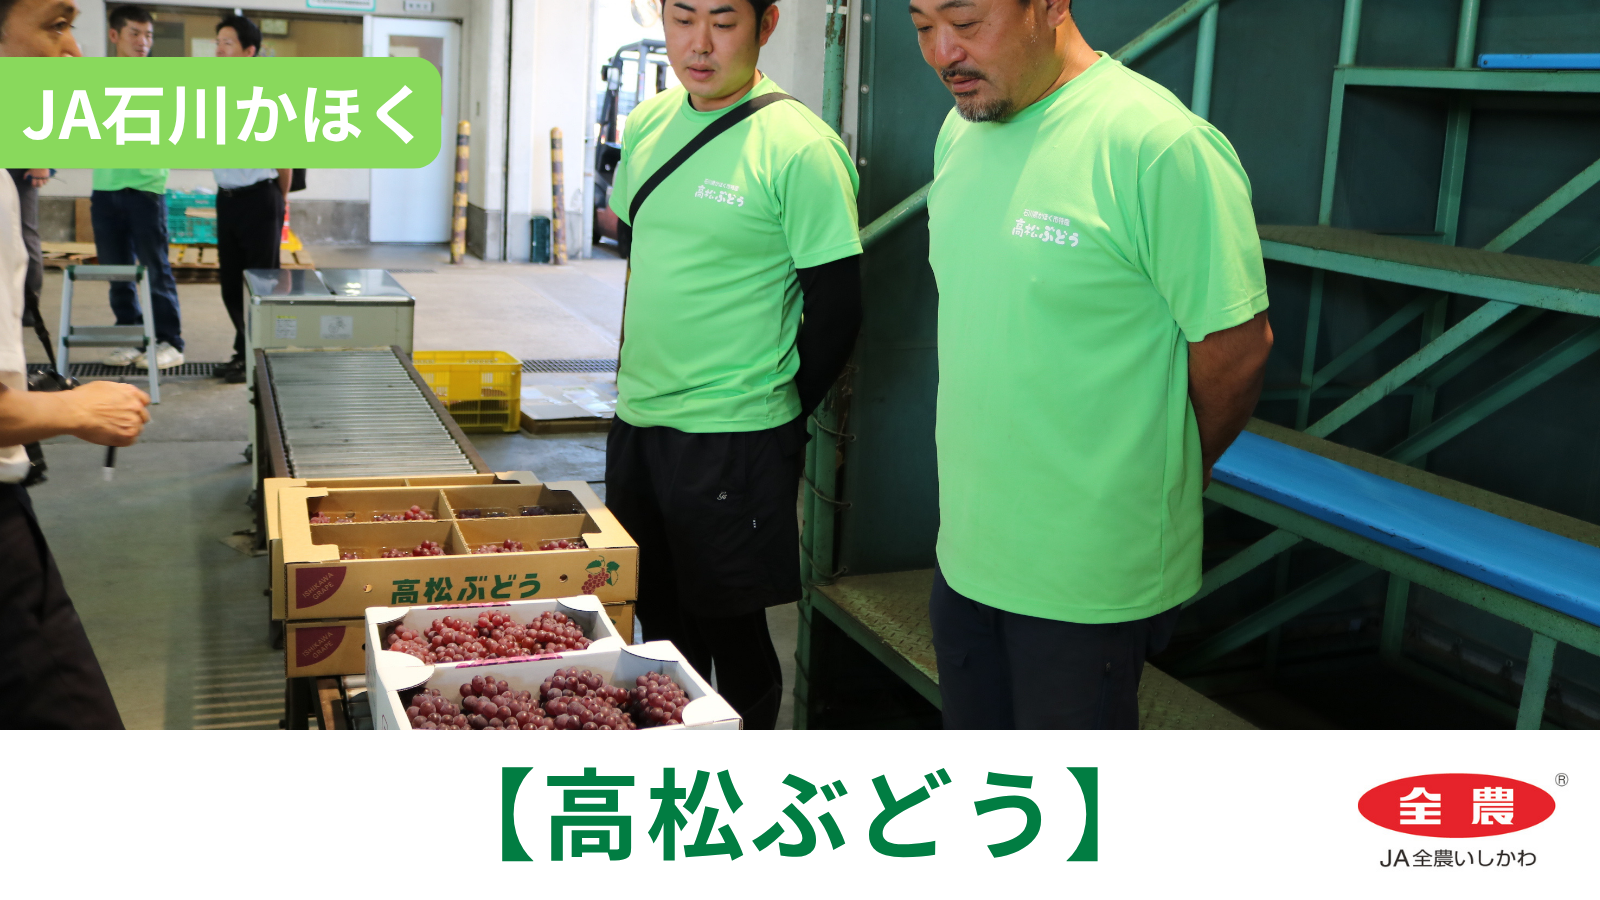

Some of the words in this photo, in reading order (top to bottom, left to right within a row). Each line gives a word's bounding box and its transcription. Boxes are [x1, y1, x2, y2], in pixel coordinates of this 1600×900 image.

[694, 184, 745, 207] 高松ぶどう
[1011, 217, 1079, 248] 高松ぶどう
[302, 572, 334, 598] ISHIKAWA
[312, 581, 335, 600] GRAPE
[391, 573, 541, 605] 高松ぶどう
[302, 631, 334, 657] ISHIKAWA
